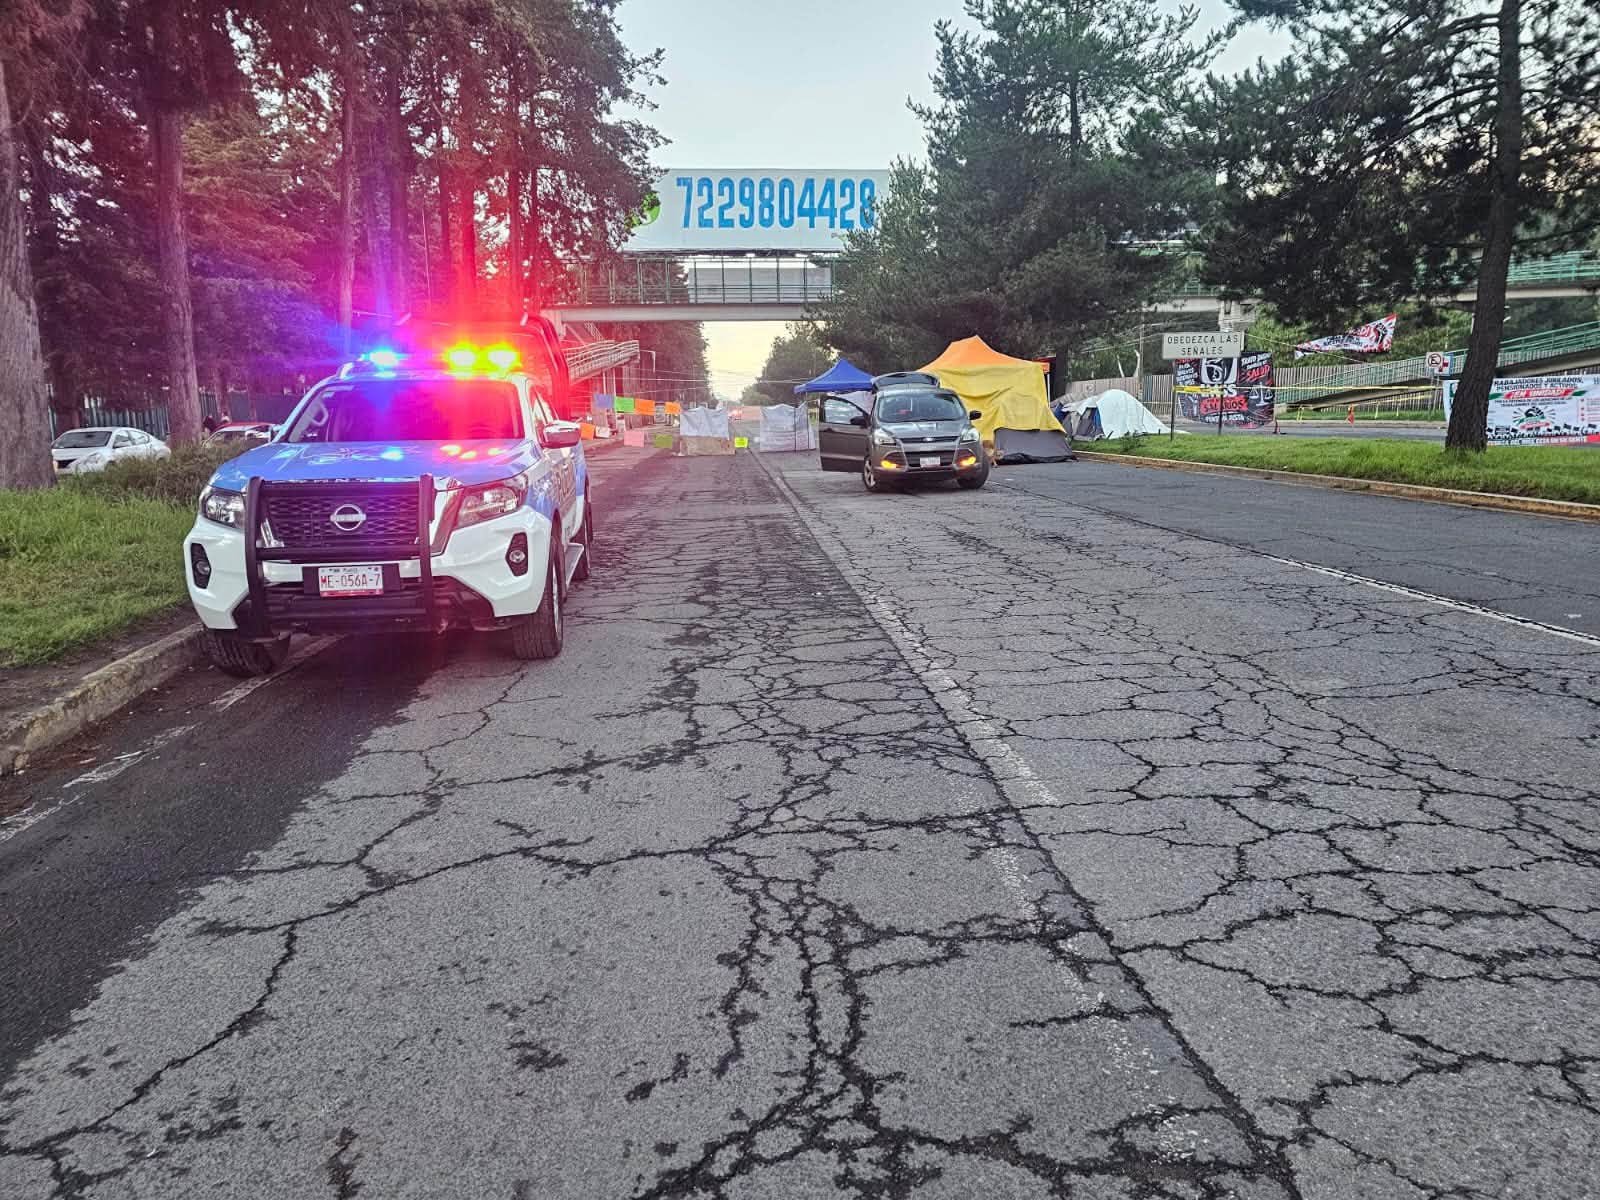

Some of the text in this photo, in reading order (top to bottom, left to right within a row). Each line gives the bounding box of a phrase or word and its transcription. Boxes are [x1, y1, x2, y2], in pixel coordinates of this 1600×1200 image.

[676, 176, 876, 229] 7229804428
[1167, 334, 1238, 344] OBEDEZCA LAS
[1181, 346, 1224, 356] SEÑALES
